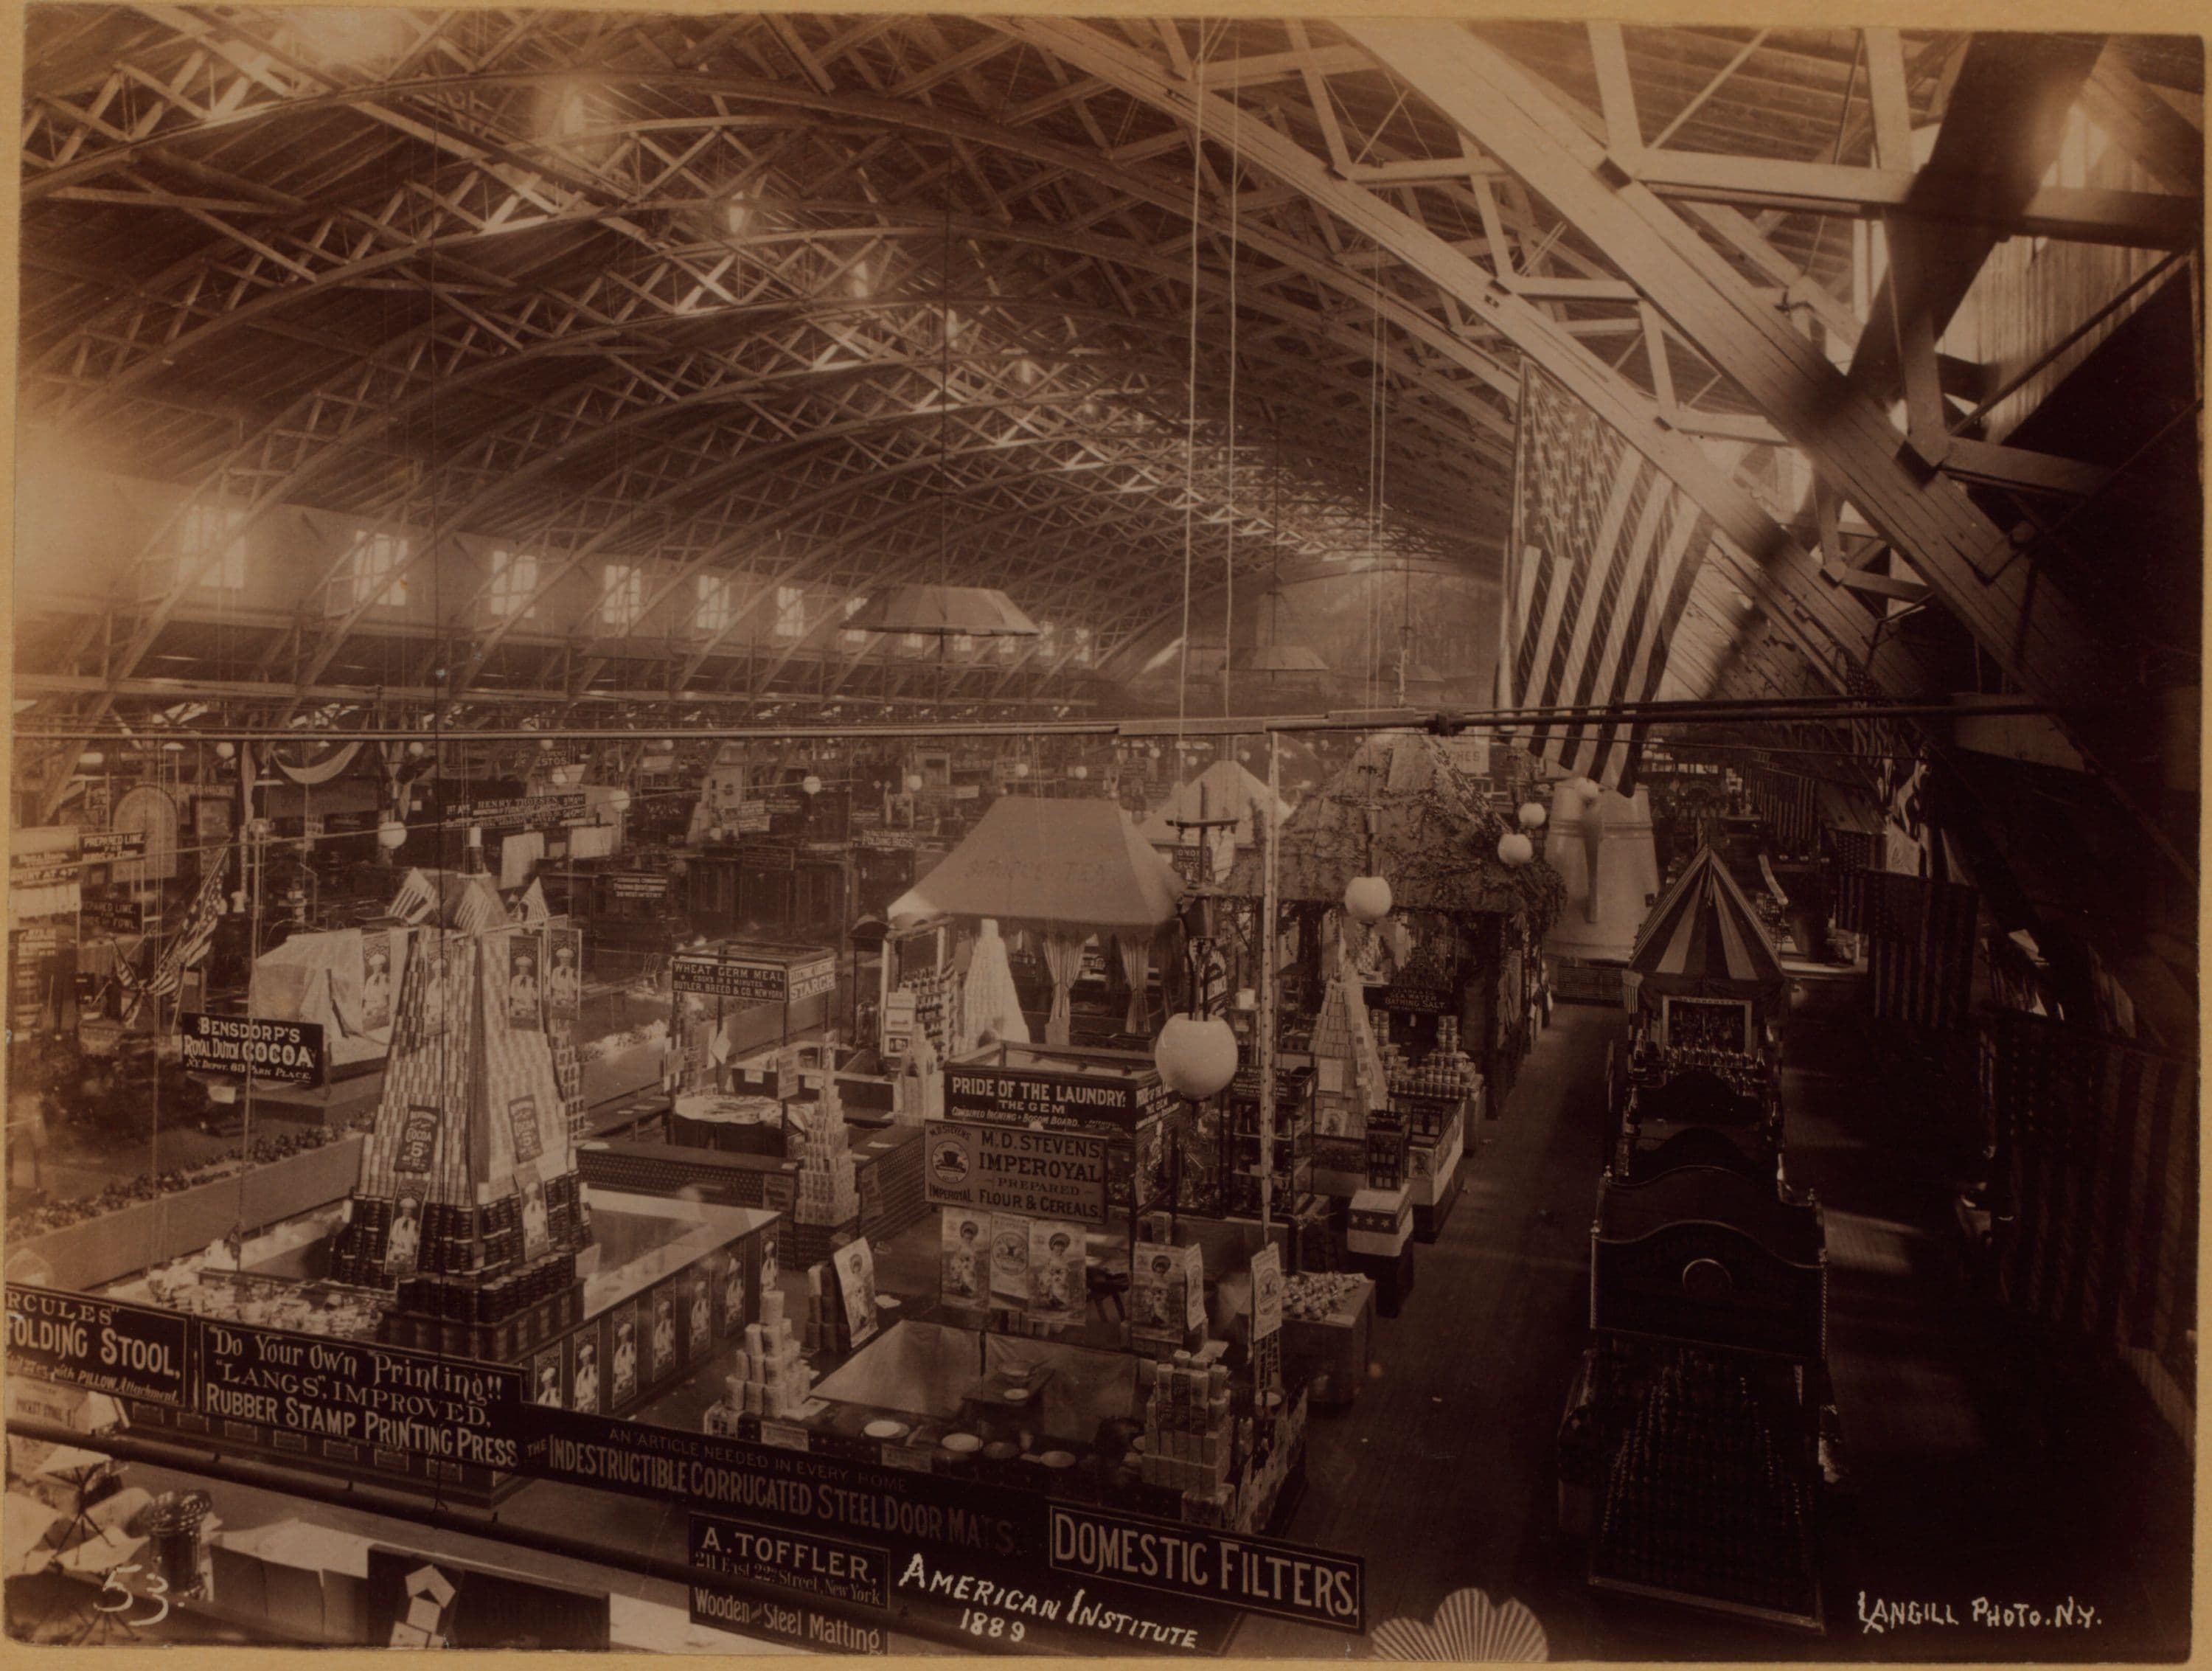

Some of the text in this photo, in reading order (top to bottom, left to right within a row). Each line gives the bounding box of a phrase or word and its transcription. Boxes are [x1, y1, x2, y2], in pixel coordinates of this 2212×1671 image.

[84, 835, 123, 847] PREPARED
[674, 962, 712, 976] WHEAT
[718, 966, 748, 979] GERM
[754, 970, 783, 982] MEAL
[733, 985, 739, 995] &
[790, 973, 835, 999] STARCH
[200, 1016, 301, 1043] BENSDORP'S
[184, 1034, 314, 1069] ROYAL DUTCH COCOA
[952, 1077, 995, 1097] PRIDE
[998, 1079, 1015, 1099] OF
[1020, 1081, 1051, 1102] THE
[998, 1099, 1065, 1114] THE GEM
[1022, 1113, 1049, 1125] BOSOM
[979, 1151, 1102, 1184] IMPEROYAL
[928, 1182, 973, 1203] IMPEROYAL
[979, 1188, 1022, 1210] FLOUR
[1026, 1196, 1037, 1211] &
[998, 1177, 1079, 1196] PREPARED
[101, 1328, 181, 1379] STOOL,
[77, 1369, 117, 1389] PILLOW
[255, 1334, 303, 1366] Your
[309, 1344, 358, 1380] Own
[374, 1354, 502, 1406] Printing!!
[206, 1382, 516, 1467] RUBBER STAMP PRINTING PRESS
[609, 1428, 908, 1493] AN ARTICLE NEEDED IN EVERY HOME
[527, 1439, 547, 1458] THE
[549, 1434, 688, 1494] INDESTRUCTIBLE
[818, 1484, 881, 1529] STEEL
[884, 1495, 943, 1540] DOOR
[702, 1526, 877, 1586] A. TOFFLER,
[1054, 1513, 1208, 1586] DOMESTIC
[722, 1557, 750, 1577] East
[825, 1578, 848, 1598] New
[695, 1586, 750, 1623] Wooden
[764, 1602, 802, 1636] Steel
[810, 1613, 883, 1656] Matting
